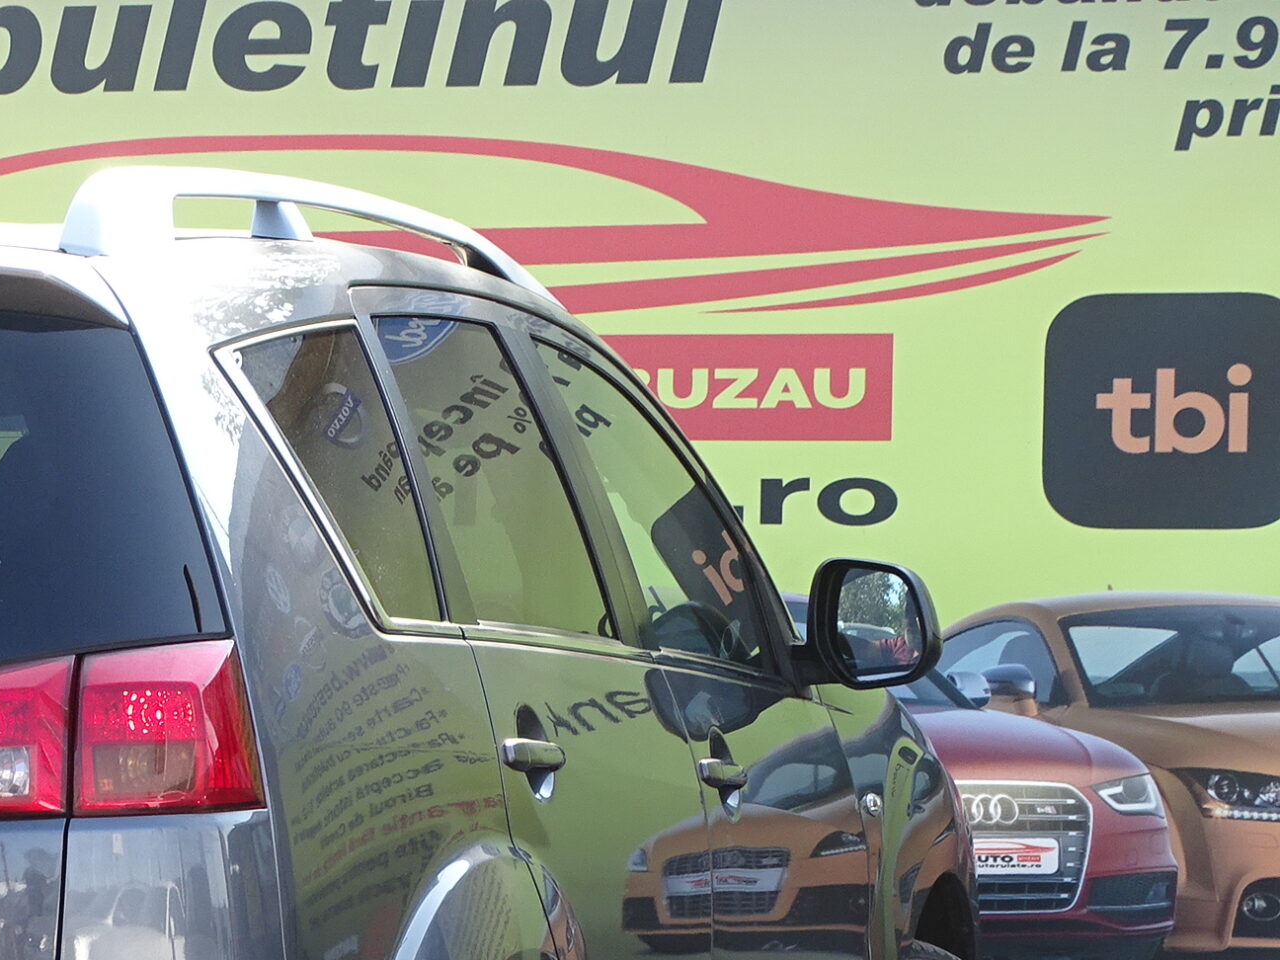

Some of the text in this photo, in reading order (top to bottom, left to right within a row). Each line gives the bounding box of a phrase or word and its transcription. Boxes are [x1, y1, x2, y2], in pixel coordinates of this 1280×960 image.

[944, 22, 1035, 74] de
[1061, 21, 1131, 72] la
[1095, 363, 1252, 454] tbi
